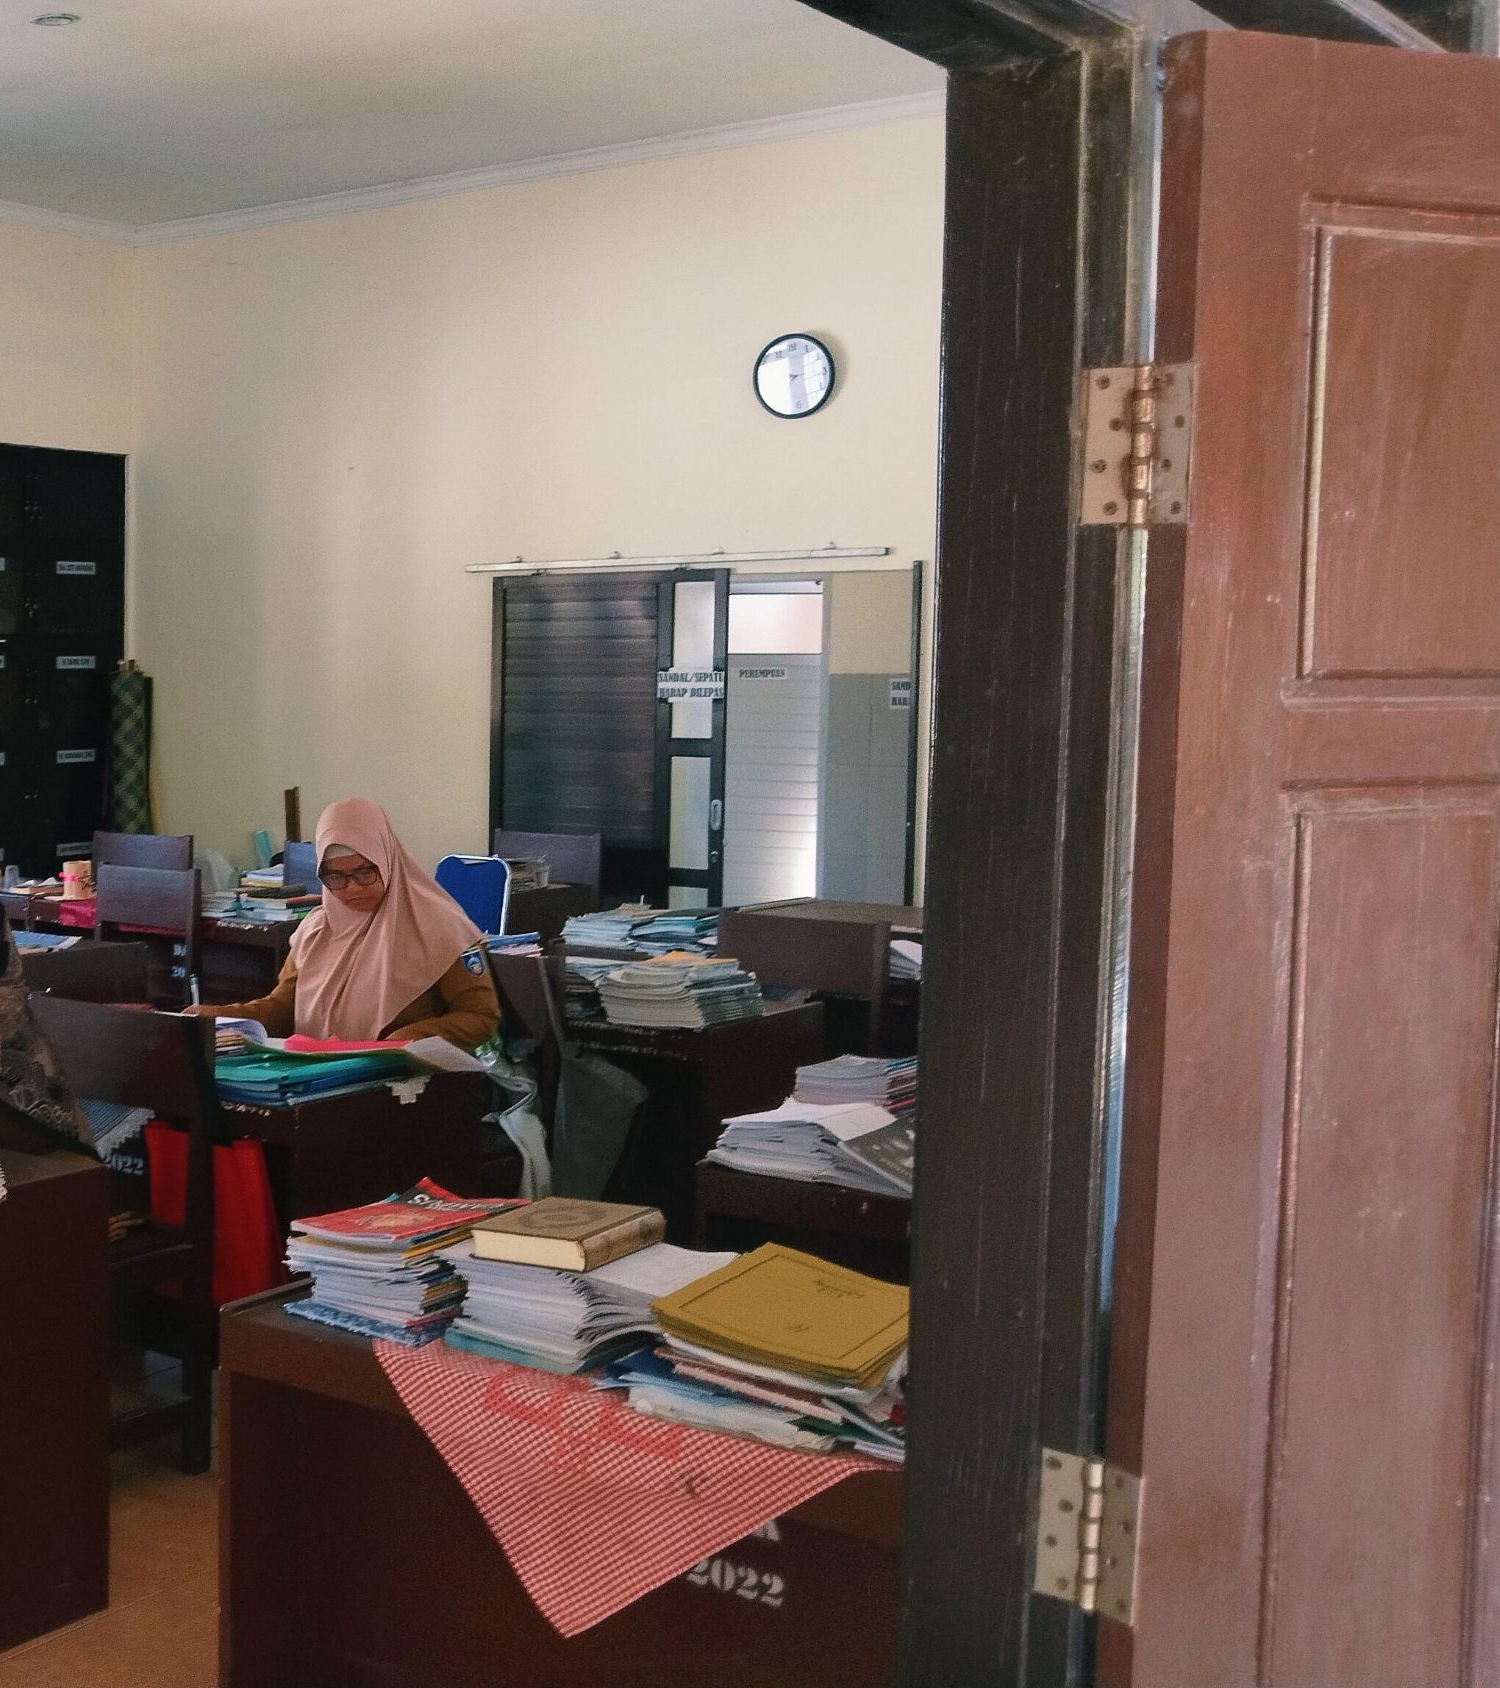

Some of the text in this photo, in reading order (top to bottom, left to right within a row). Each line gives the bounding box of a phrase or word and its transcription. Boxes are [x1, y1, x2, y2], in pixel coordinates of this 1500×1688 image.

[659, 672, 724, 683] SANDAL/SEPATU
[659, 687, 724, 698] HARAP DILEPAS
[686, 1558, 784, 1607] 2022
